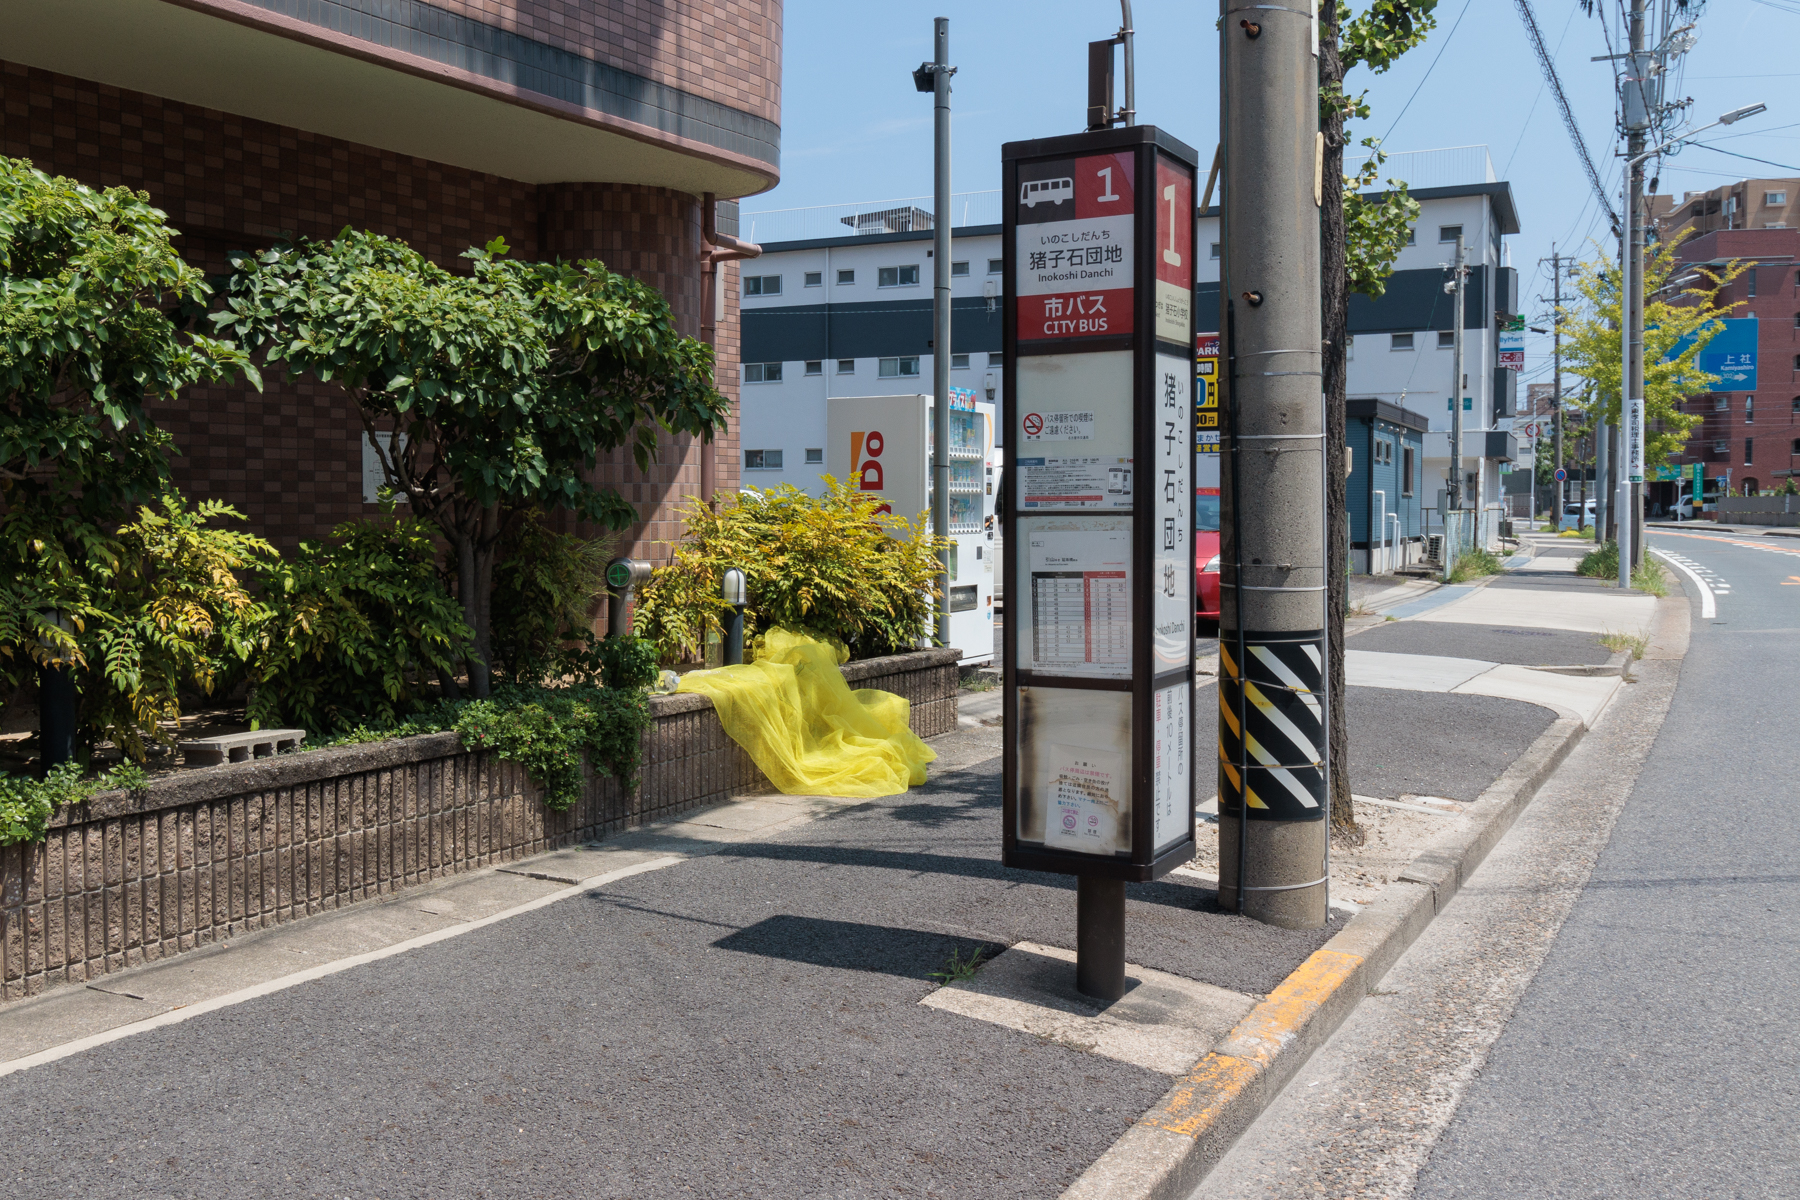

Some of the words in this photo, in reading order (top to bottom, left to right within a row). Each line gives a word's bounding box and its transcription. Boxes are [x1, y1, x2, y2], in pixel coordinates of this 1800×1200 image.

[1096, 166, 1120, 203] 1
[1163, 183, 1182, 268] 1
[1040, 229, 1111, 245] いのこしだんち
[1029, 244, 1123, 271] 猪子石団地
[1038, 270, 1078, 283] Inokoshi
[1080, 267, 1114, 280] Danchi
[1043, 294, 1107, 318] 市バス
[1043, 320, 1077, 335] CITY
[1079, 317, 1108, 333] BUS
[1197, 347, 1219, 356] ARK
[1724, 354, 1751, 365] 上社
[1720, 364, 1755, 372] Kamiyashiro
[1722, 372, 1734, 380] 302
[1044, 413, 1093, 423] バス停留所での喫煙は
[1163, 372, 1176, 597] 猪子石団地
